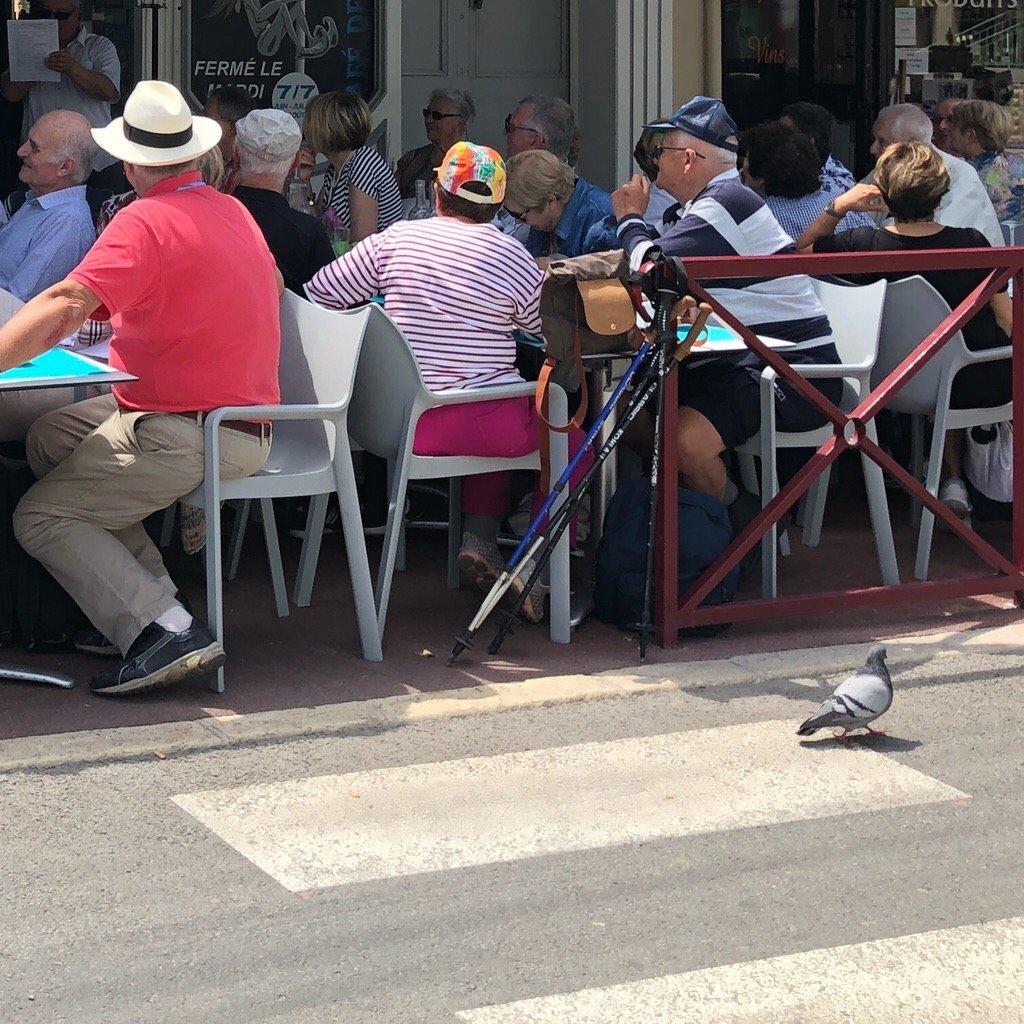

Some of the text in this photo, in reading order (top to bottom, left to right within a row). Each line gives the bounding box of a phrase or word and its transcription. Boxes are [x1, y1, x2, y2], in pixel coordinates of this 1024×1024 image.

[748, 36, 786, 64] Vins
[194, 57, 283, 76] FERMÉ LE
[207, 83, 266, 99] MDI
